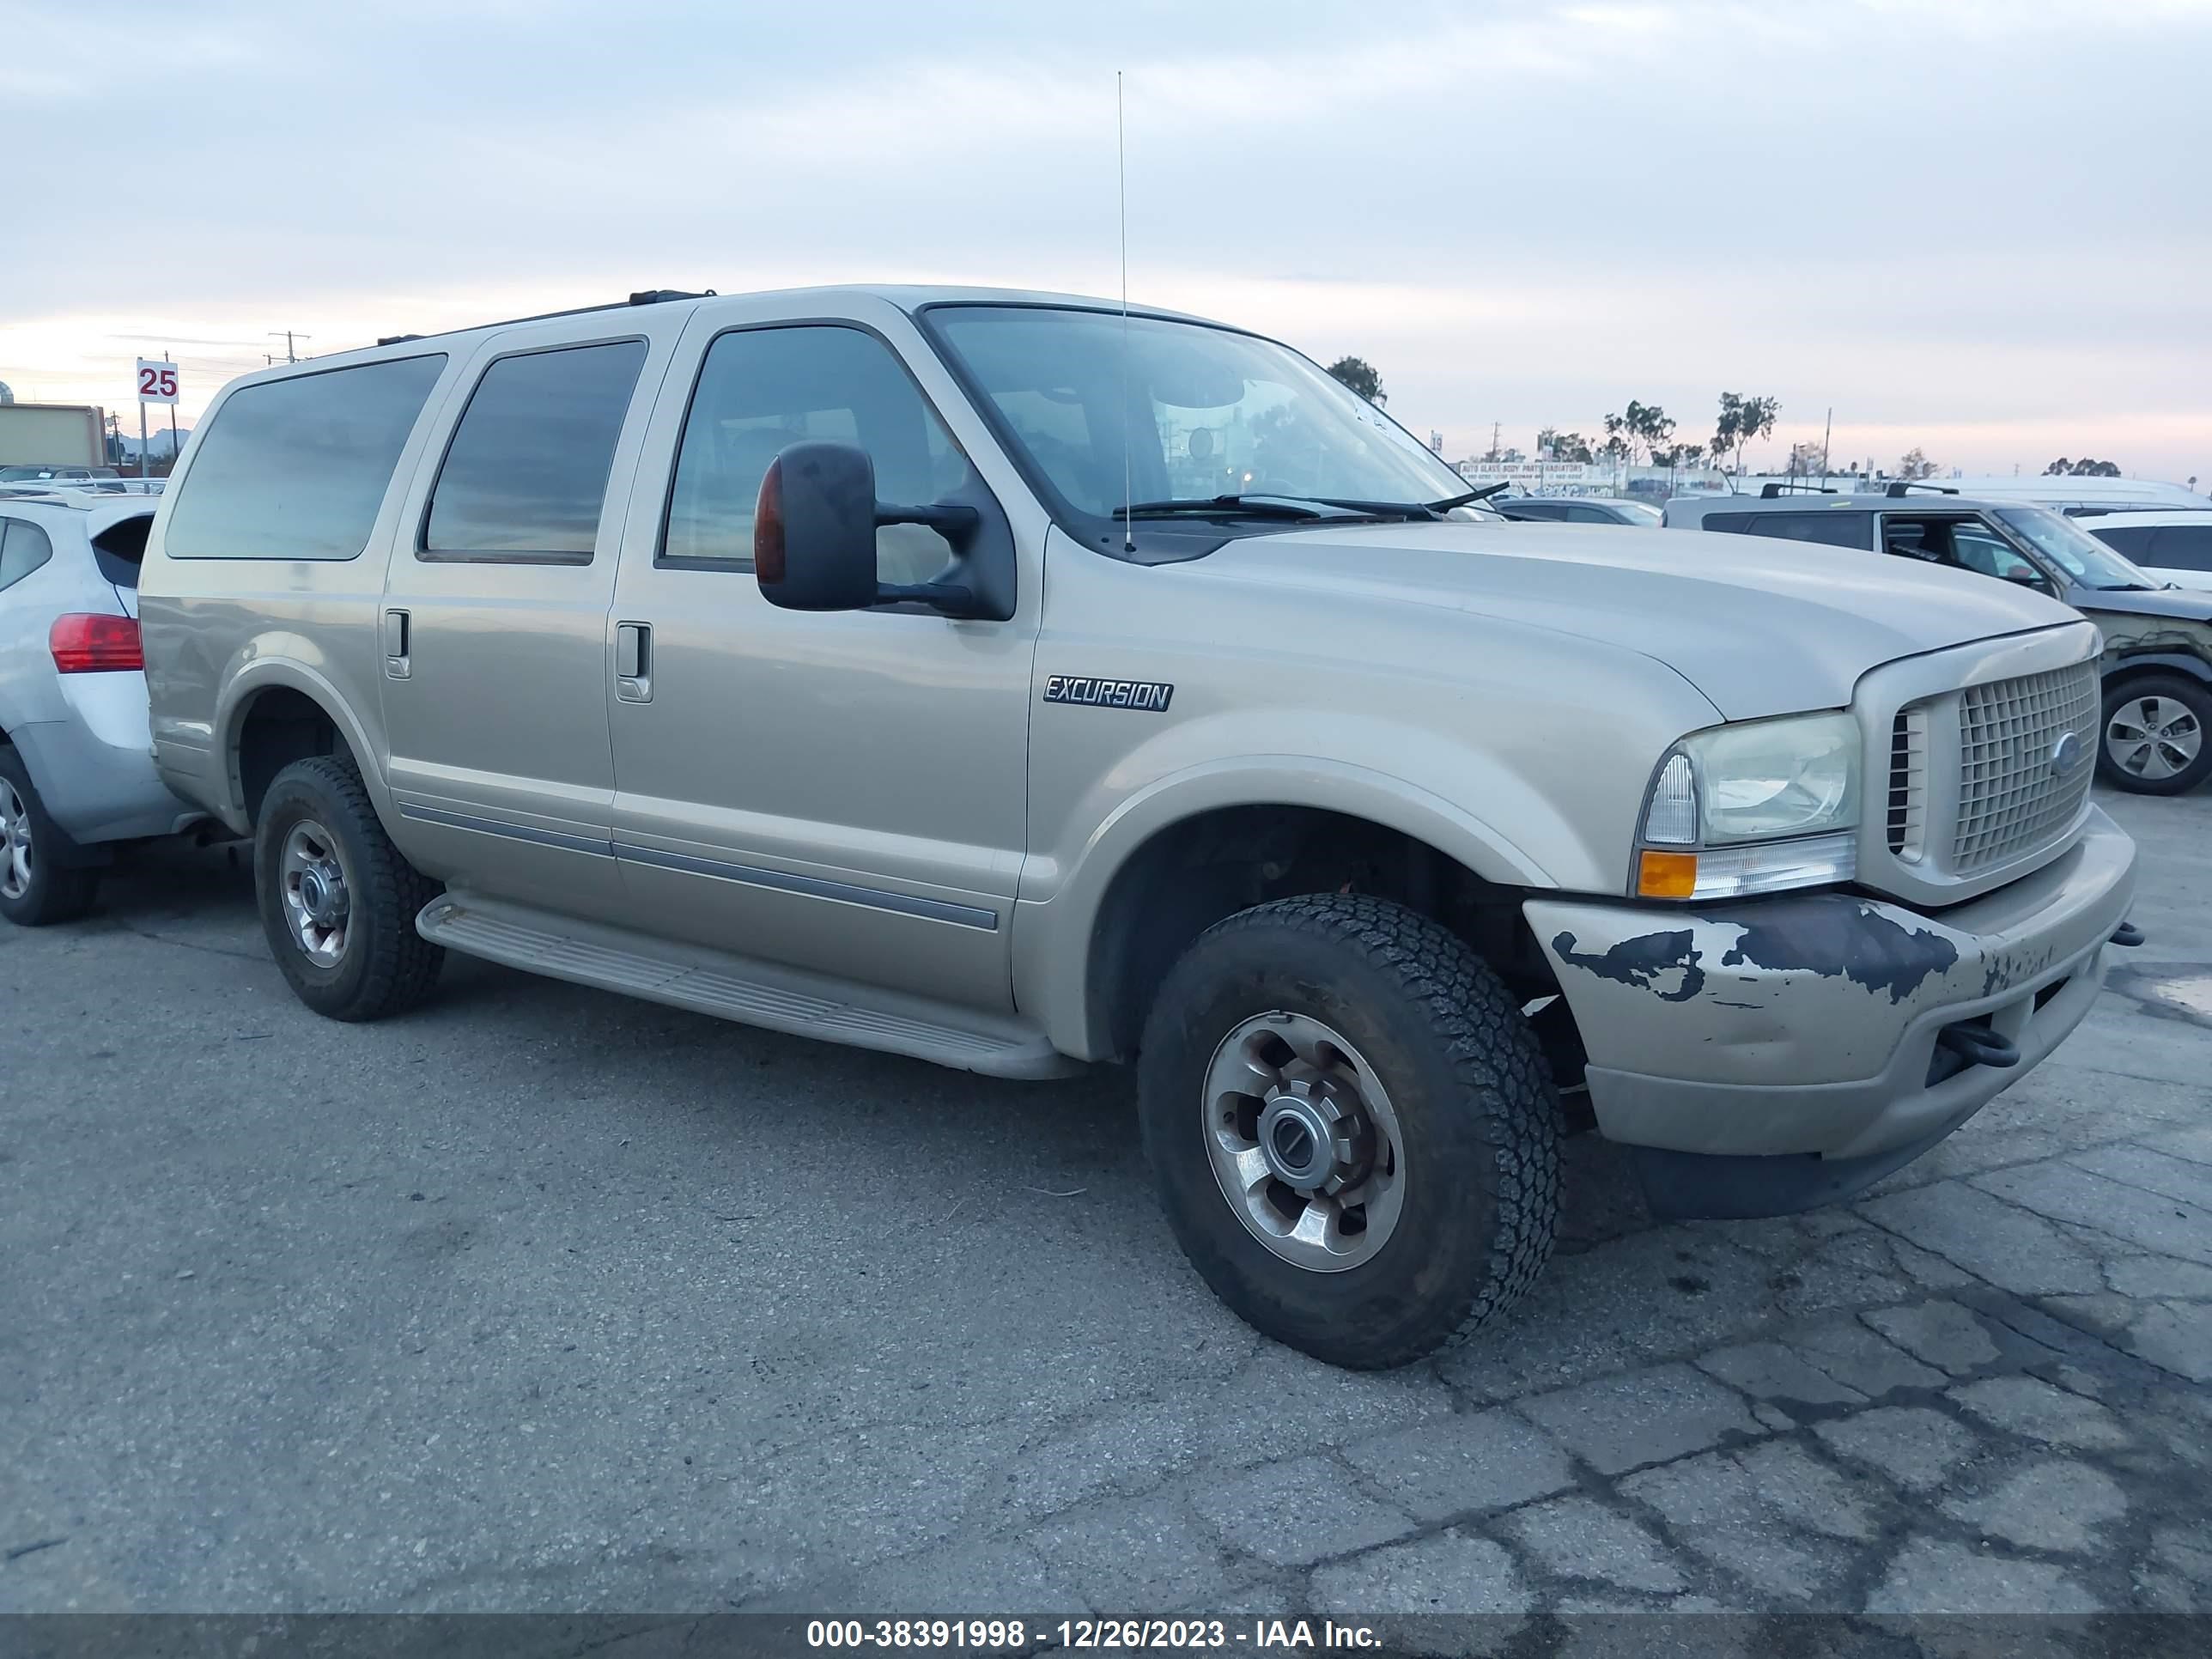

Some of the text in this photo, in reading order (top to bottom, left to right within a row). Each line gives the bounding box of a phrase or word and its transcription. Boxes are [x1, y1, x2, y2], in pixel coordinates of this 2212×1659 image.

[140, 368, 177, 397] 25
[1432, 437, 1443, 451] 19
[1044, 677, 1170, 709] EXCURSION
